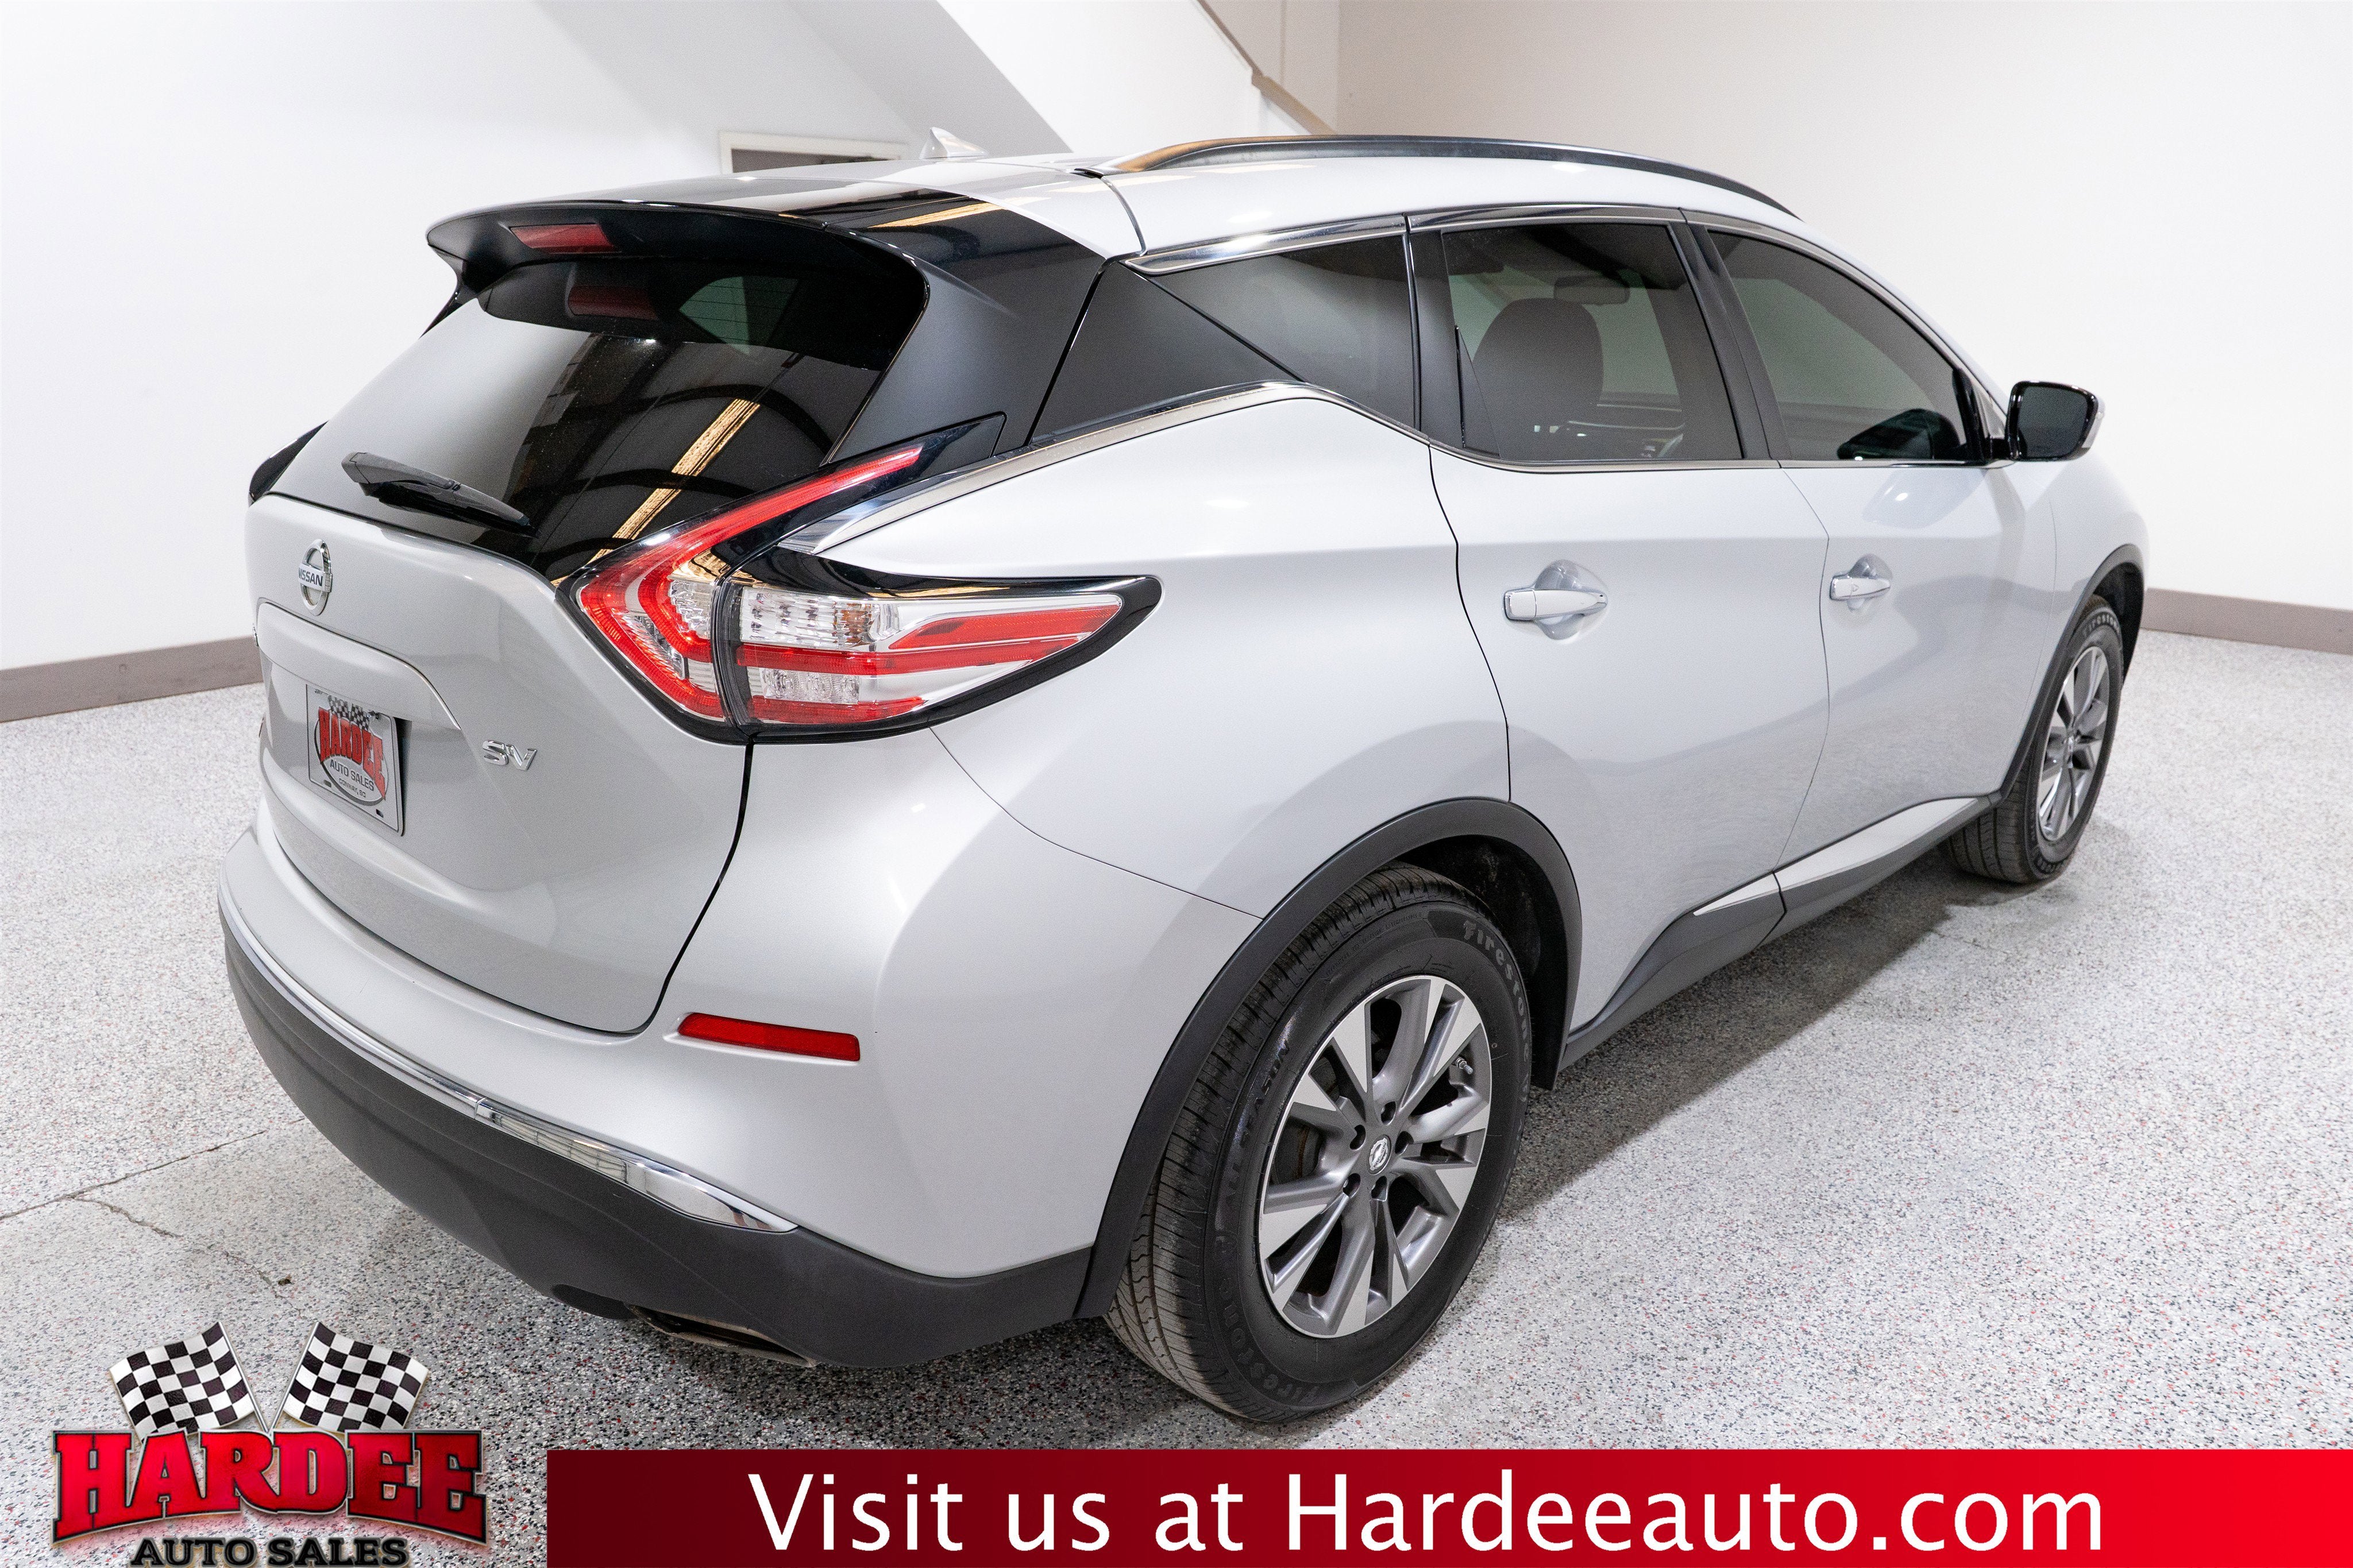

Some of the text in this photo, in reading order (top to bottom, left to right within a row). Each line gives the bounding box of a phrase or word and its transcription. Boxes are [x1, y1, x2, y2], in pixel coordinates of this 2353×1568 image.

[299, 567, 323, 586] NISSAN
[319, 706, 385, 800] HARDEE
[483, 740, 537, 771] SV
[330, 759, 374, 791] AUTO SALES
